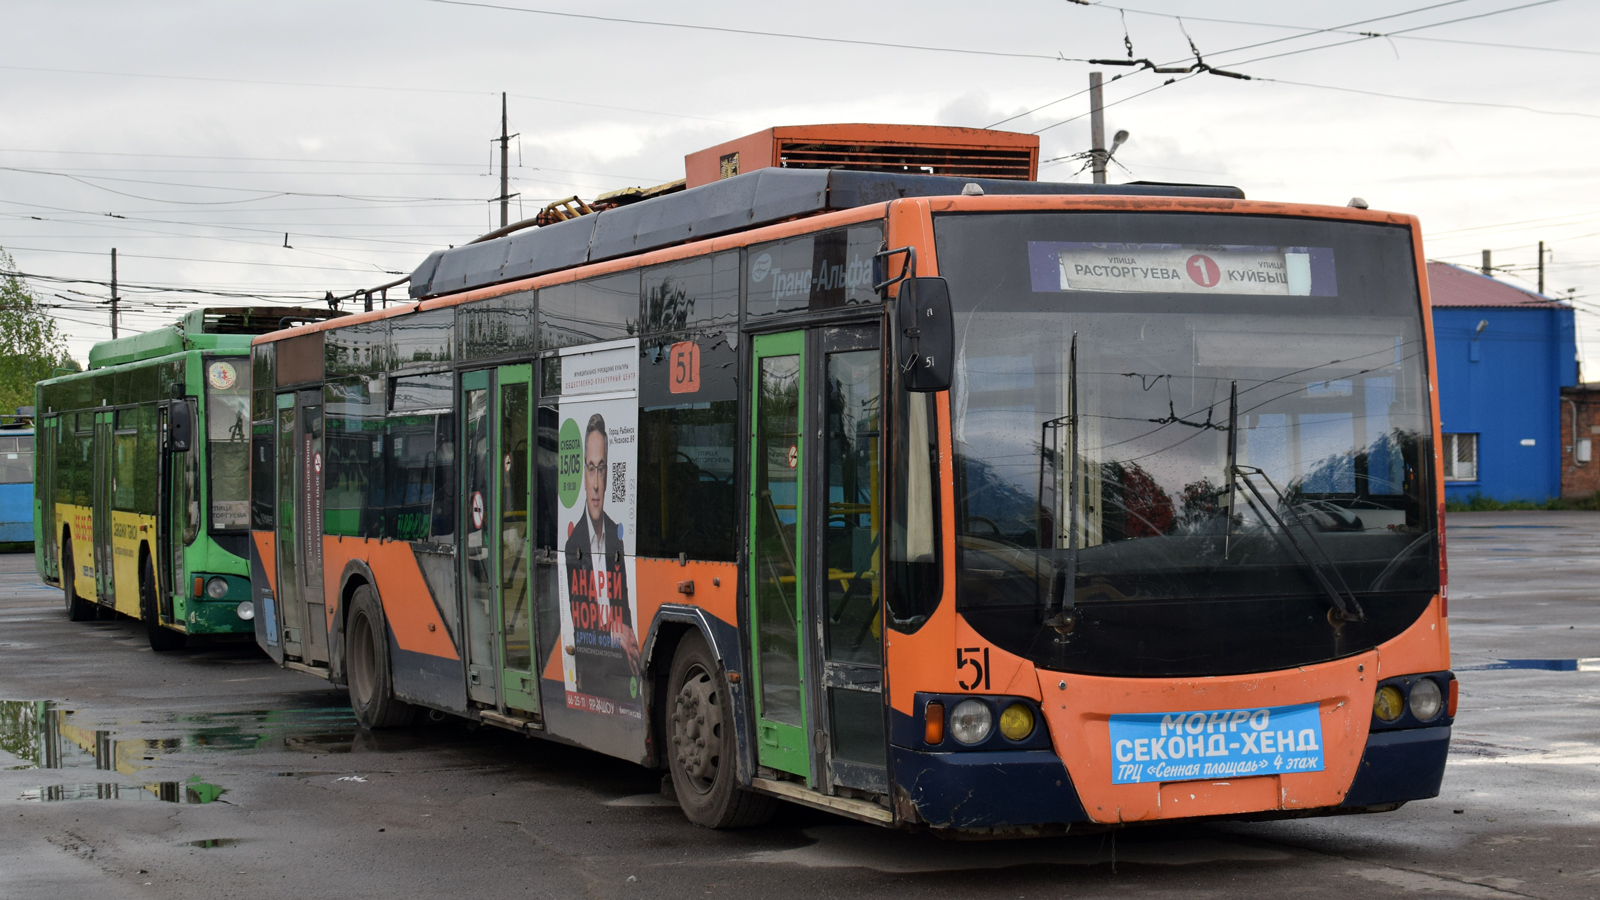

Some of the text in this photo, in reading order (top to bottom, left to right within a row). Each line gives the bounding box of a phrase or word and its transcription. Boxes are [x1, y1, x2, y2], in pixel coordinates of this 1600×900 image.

[1075, 263, 1181, 281] РАСТОРГУЕВА
[1107, 256, 1136, 265] УЛИЦА
[1192, 257, 1211, 285] 1
[1257, 261, 1285, 270] УЛИЦА
[770, 253, 873, 306] Транс-Альфа
[676, 350, 694, 384] 51
[924, 355, 935, 368] 51
[565, 372, 636, 389] ОБЩЕСТВЕННО-КУЛЬТУРНЫЙ ЦЕНТР
[560, 439, 580, 450] СУББОТА
[560, 453, 581, 477] 15/05
[571, 564, 623, 603] АНДРЕЙ
[571, 601, 624, 633] НОРКИН
[576, 630, 623, 650] ДРУГОЙ ФОРМАТ
[956, 647, 991, 691] 51
[1160, 709, 1270, 737] МОНРО
[1115, 728, 1319, 762] СЕКОНД-ХЕНД
[1118, 754, 1319, 783] ТРЦ «Сенная площадь» 4 этаж
